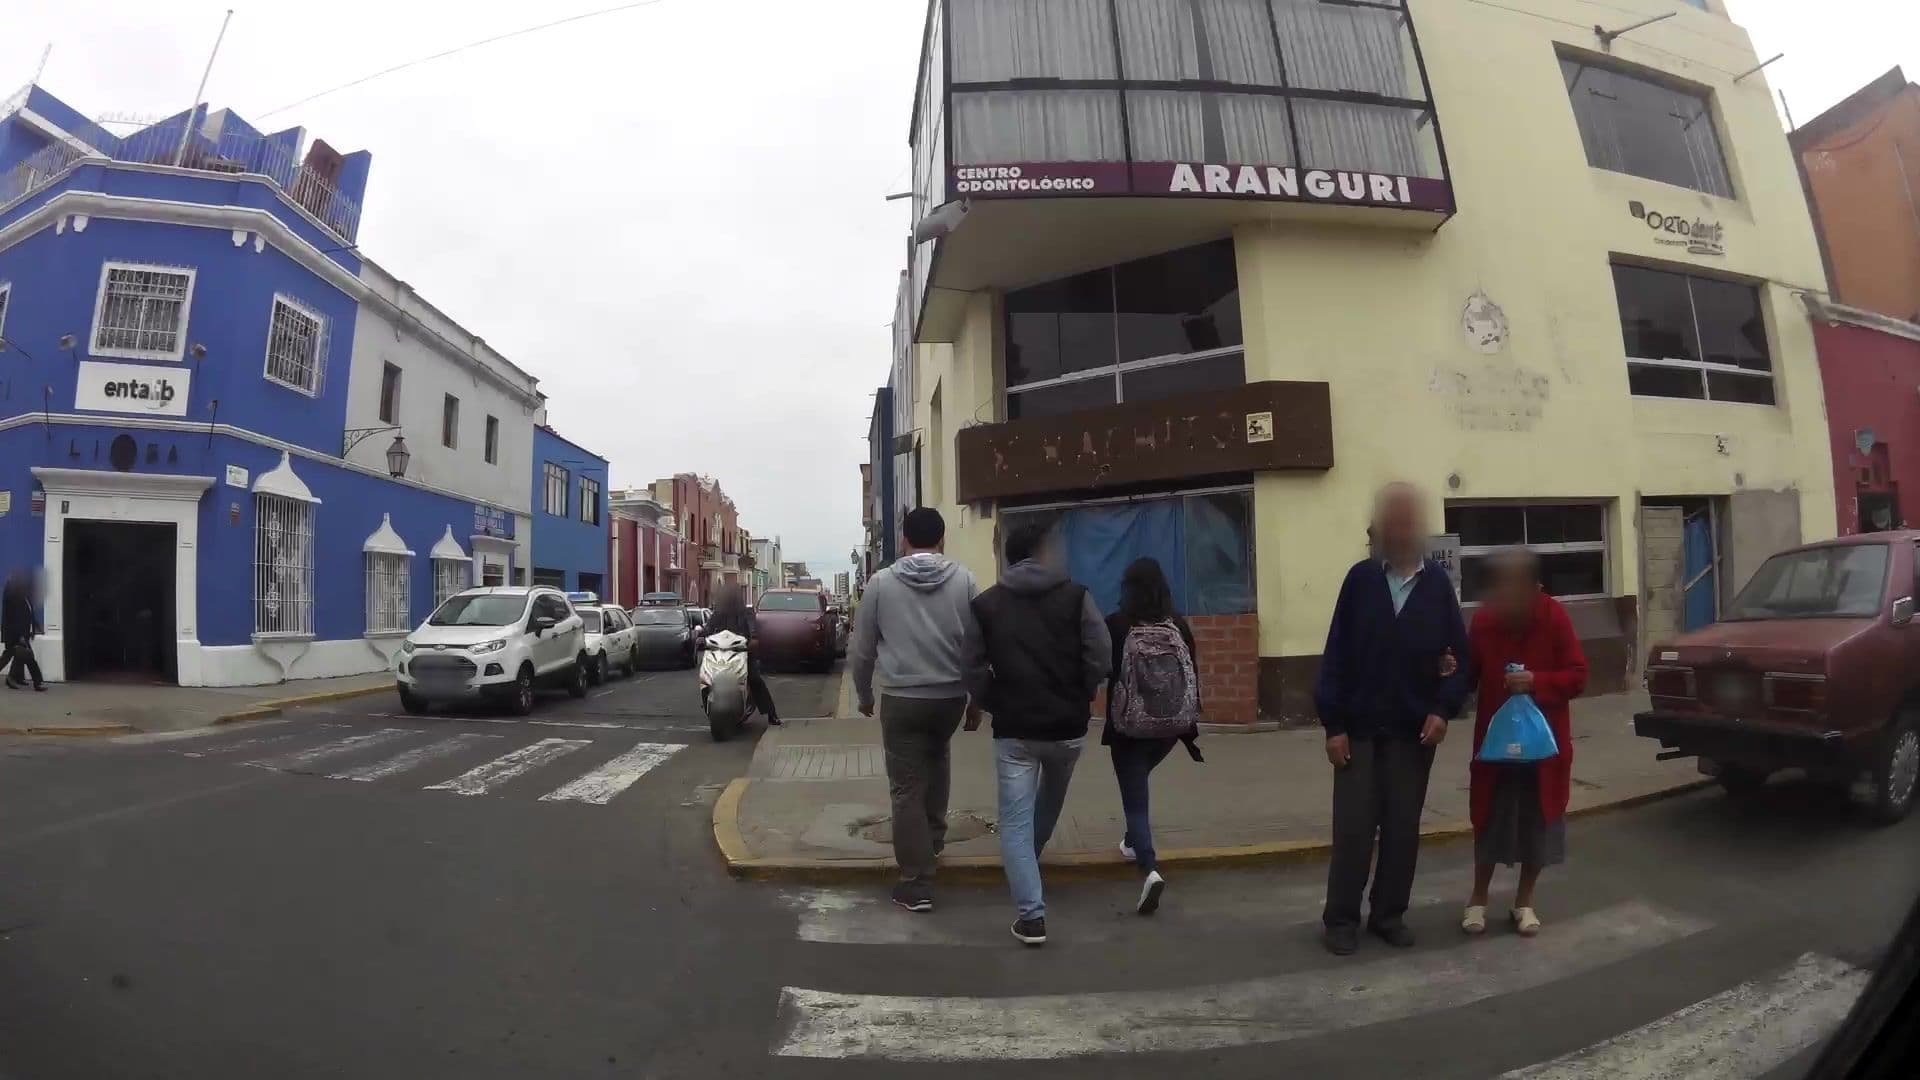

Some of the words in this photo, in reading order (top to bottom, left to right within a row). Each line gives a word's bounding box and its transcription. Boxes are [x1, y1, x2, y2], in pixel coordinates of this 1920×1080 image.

[957, 166, 1021, 180] CENTRO
[957, 175, 1095, 193] ODONTOLÓGICO
[1169, 163, 1412, 203] ARANGURI
